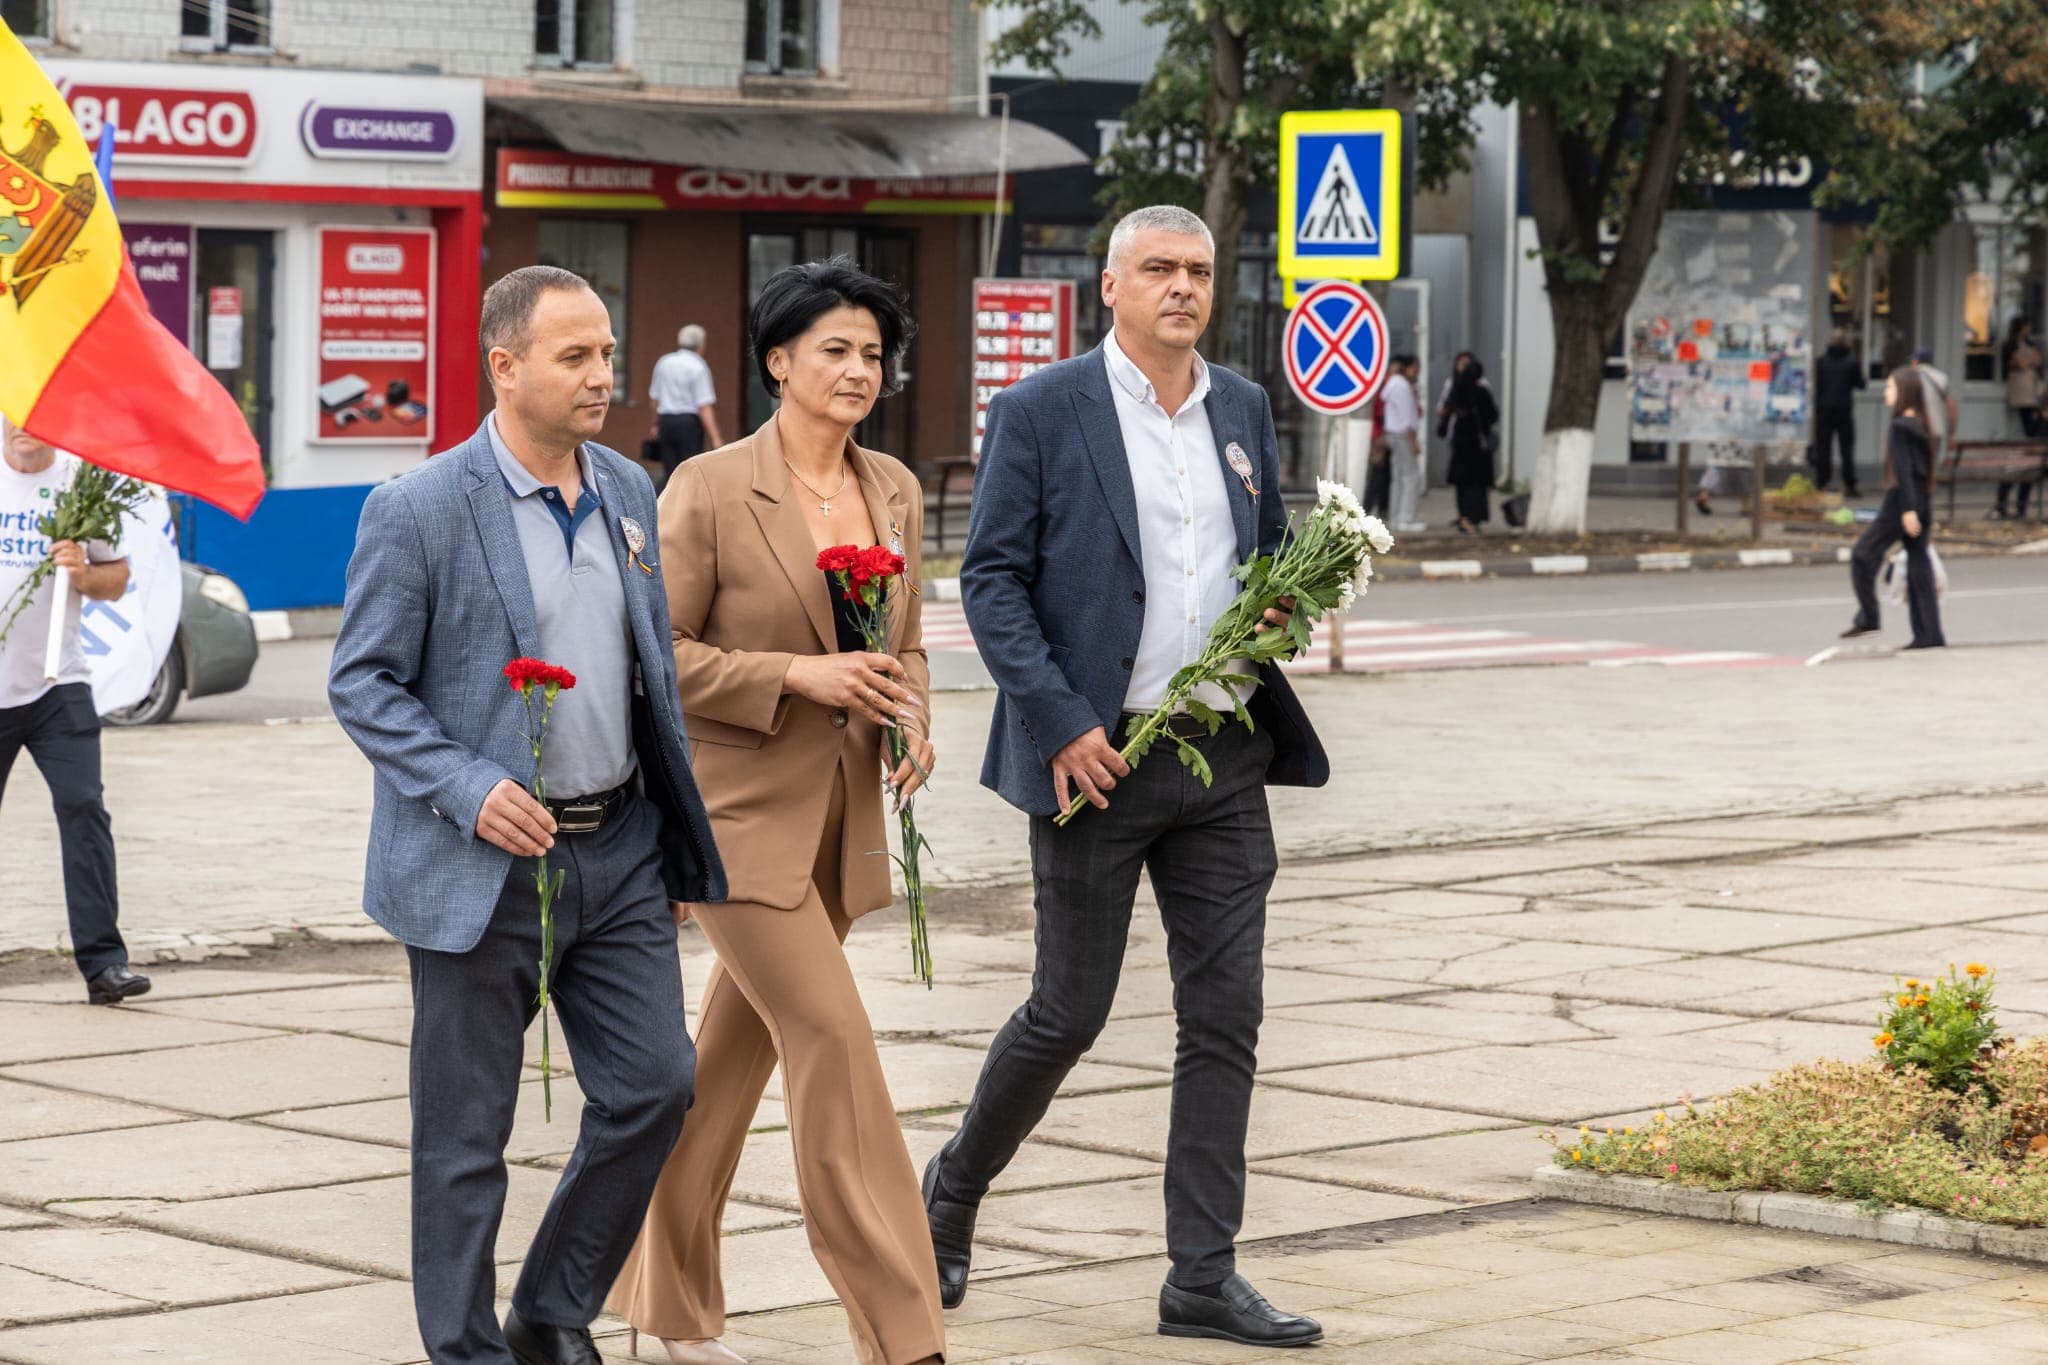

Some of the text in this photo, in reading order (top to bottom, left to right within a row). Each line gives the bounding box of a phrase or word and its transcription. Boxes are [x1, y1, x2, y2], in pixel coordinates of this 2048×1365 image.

[72, 95, 248, 148] BLAGO
[332, 117, 435, 143] EXCHANGE
[131, 236, 189, 257] oferim
[139, 262, 180, 282] mult
